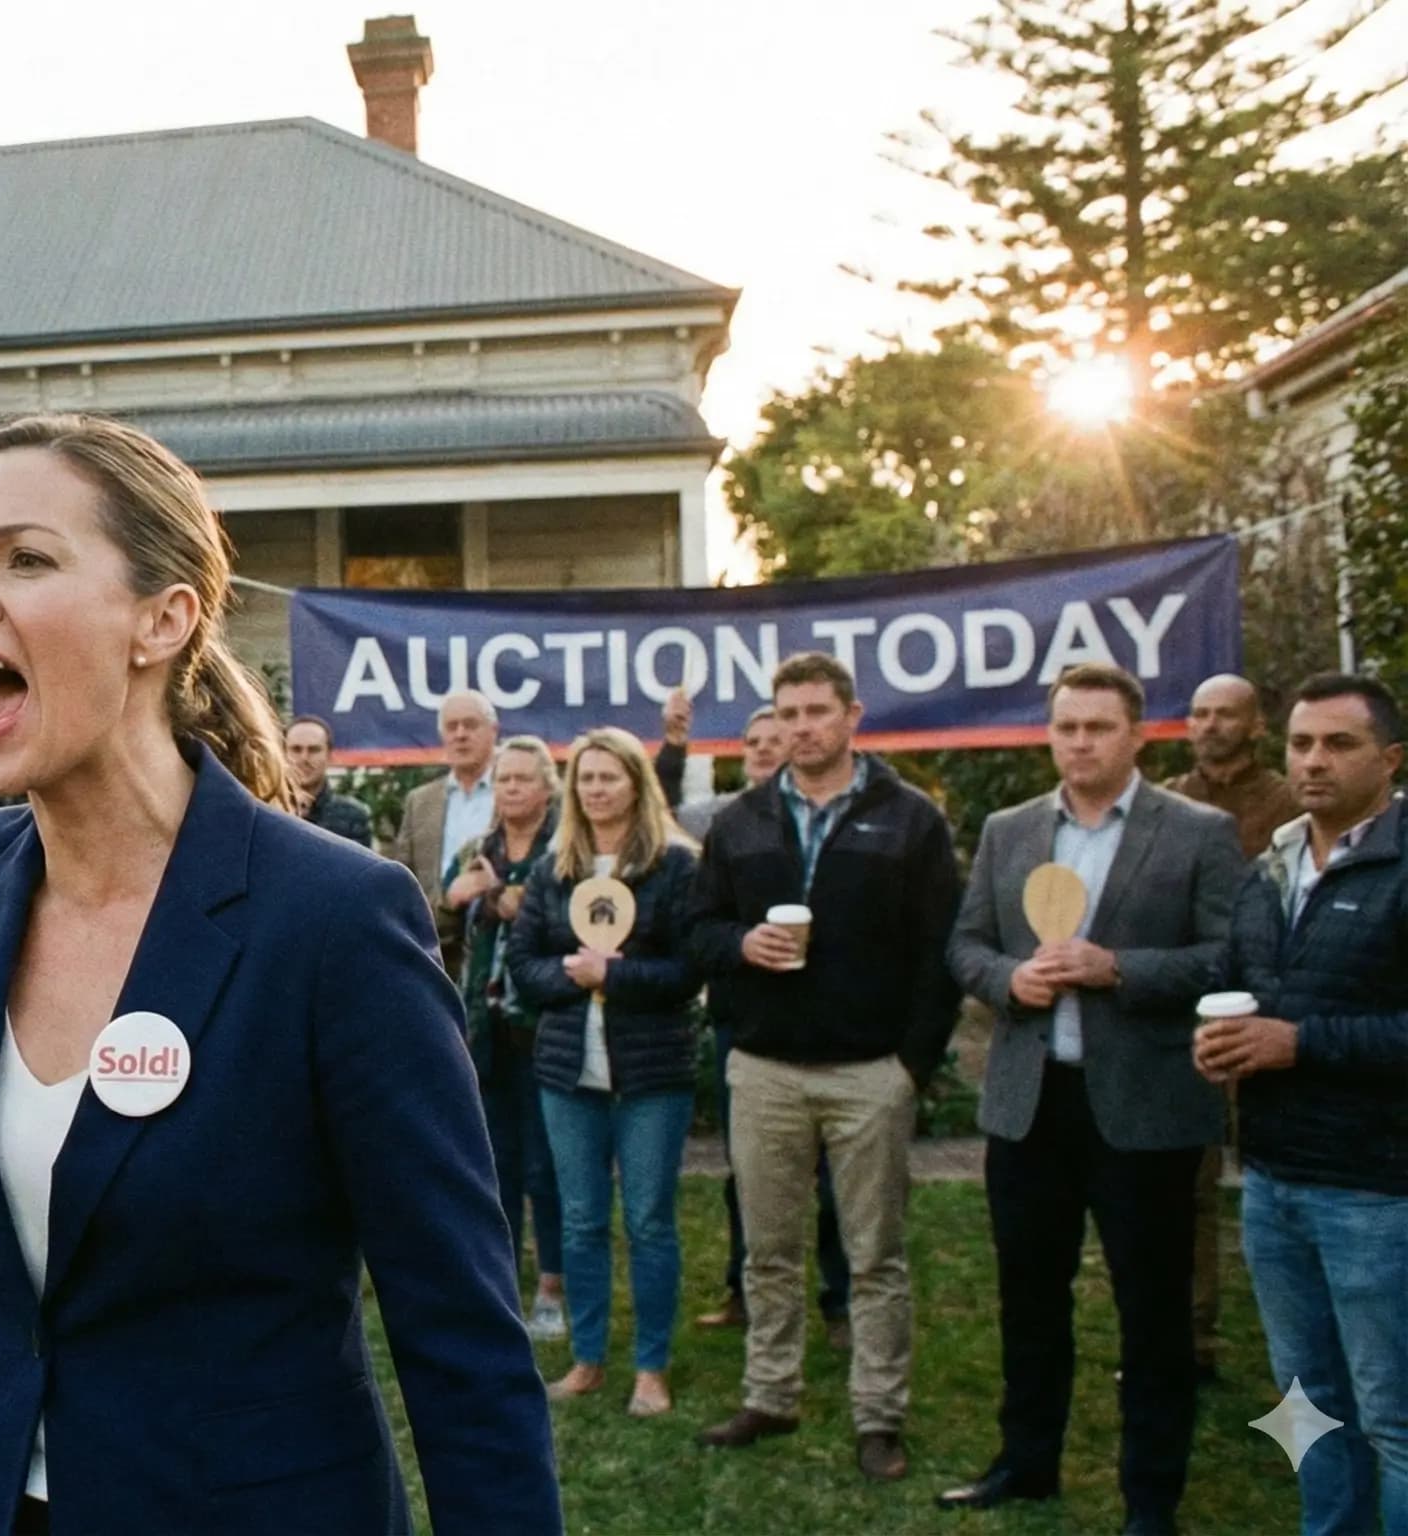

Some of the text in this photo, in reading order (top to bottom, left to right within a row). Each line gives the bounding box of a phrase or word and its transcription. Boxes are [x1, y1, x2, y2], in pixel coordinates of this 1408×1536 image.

[333, 593, 1188, 712] AUCTION TODAY
[97, 1046, 180, 1077] Sold!
